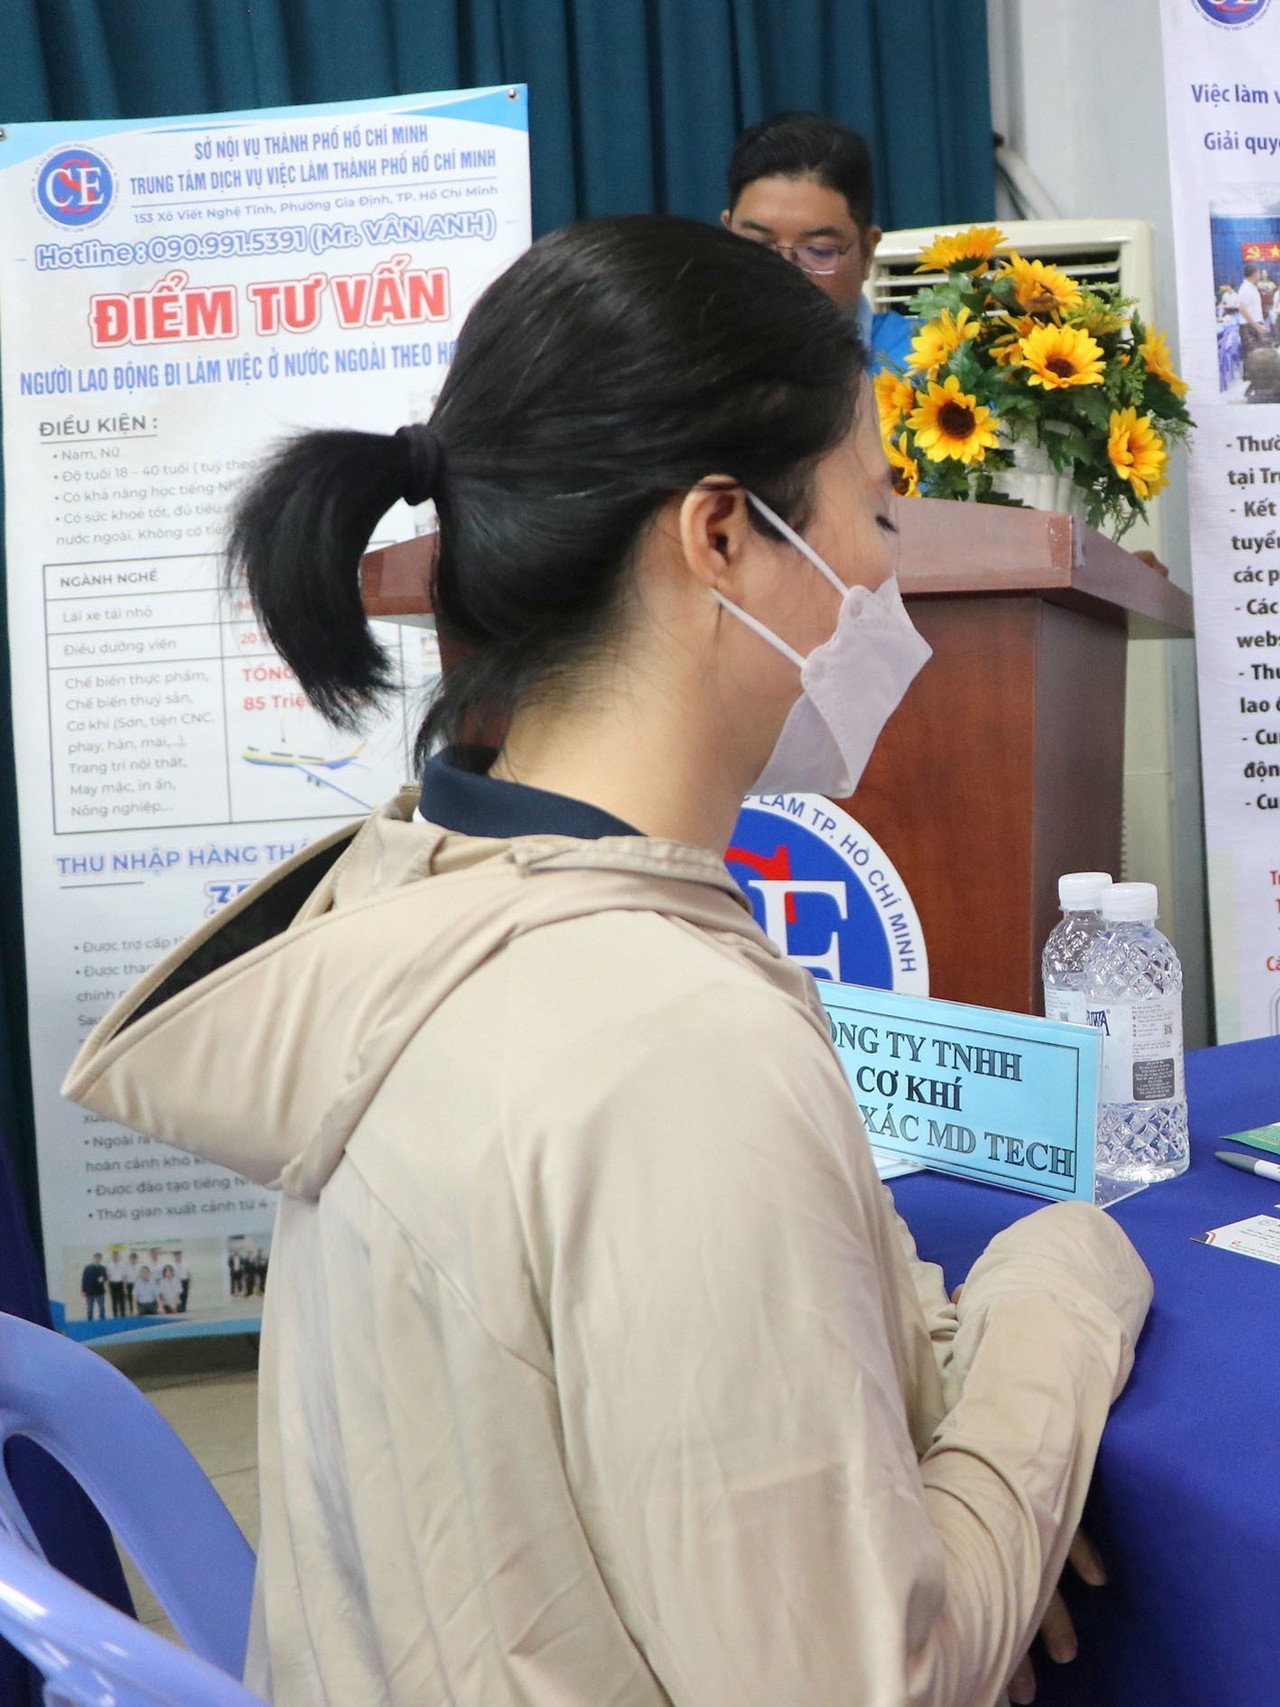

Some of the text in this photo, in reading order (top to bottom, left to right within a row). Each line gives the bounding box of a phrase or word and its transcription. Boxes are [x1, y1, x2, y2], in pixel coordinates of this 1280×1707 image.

[1191, 84, 1230, 107] Việc
[1235, 84, 1268, 104] làm
[195, 124, 428, 160] SỞ NỘI VỤ THÀNH PHỐ HỒ CHÍ MINH
[1204, 130, 1239, 150] Giải
[130, 149, 496, 195] TRUNG TÂM DỊCH VỤ VIỆC LÀM THÀNH PHỐ HỒ CHÍ MINH
[150, 226, 307, 261] 090.991.5391
[309, 223, 362, 255] (Mr.
[362, 213, 423, 245] VÂN
[423, 209, 496, 240] ANH)
[92, 254, 450, 346] ĐIỂM TƯ VẤN
[20, 365, 72, 395] NGƯỜI
[78, 368, 108, 392] LAO
[113, 361, 159, 390] ĐỘNG
[164, 363, 180, 386] ĐI
[186, 356, 221, 384] LÀM
[227, 352, 262, 384] VIỆC
[268, 349, 279, 378] Ở
[284, 347, 329, 377] NƯỚC
[335, 342, 386, 373] NGOÀI
[391, 342, 432, 368] THEO
[39, 413, 146, 436] ĐIỀU KIỆN
[1228, 468, 1255, 490] tại
[1240, 697, 1270, 713] lao
[56, 844, 258, 874] THU NHẬP HÀNG
[807, 808, 836, 839] TP.
[840, 834, 869, 866] HỒ
[868, 870, 902, 908] CHÍ
[889, 913, 917, 972] MINH
[886, 1030, 926, 1062] TY
[932, 1039, 1022, 1082] TNHH
[856, 1066, 962, 1111] CƠ KHÍ
[859, 1103, 1075, 1178] XÁC MD TECH
